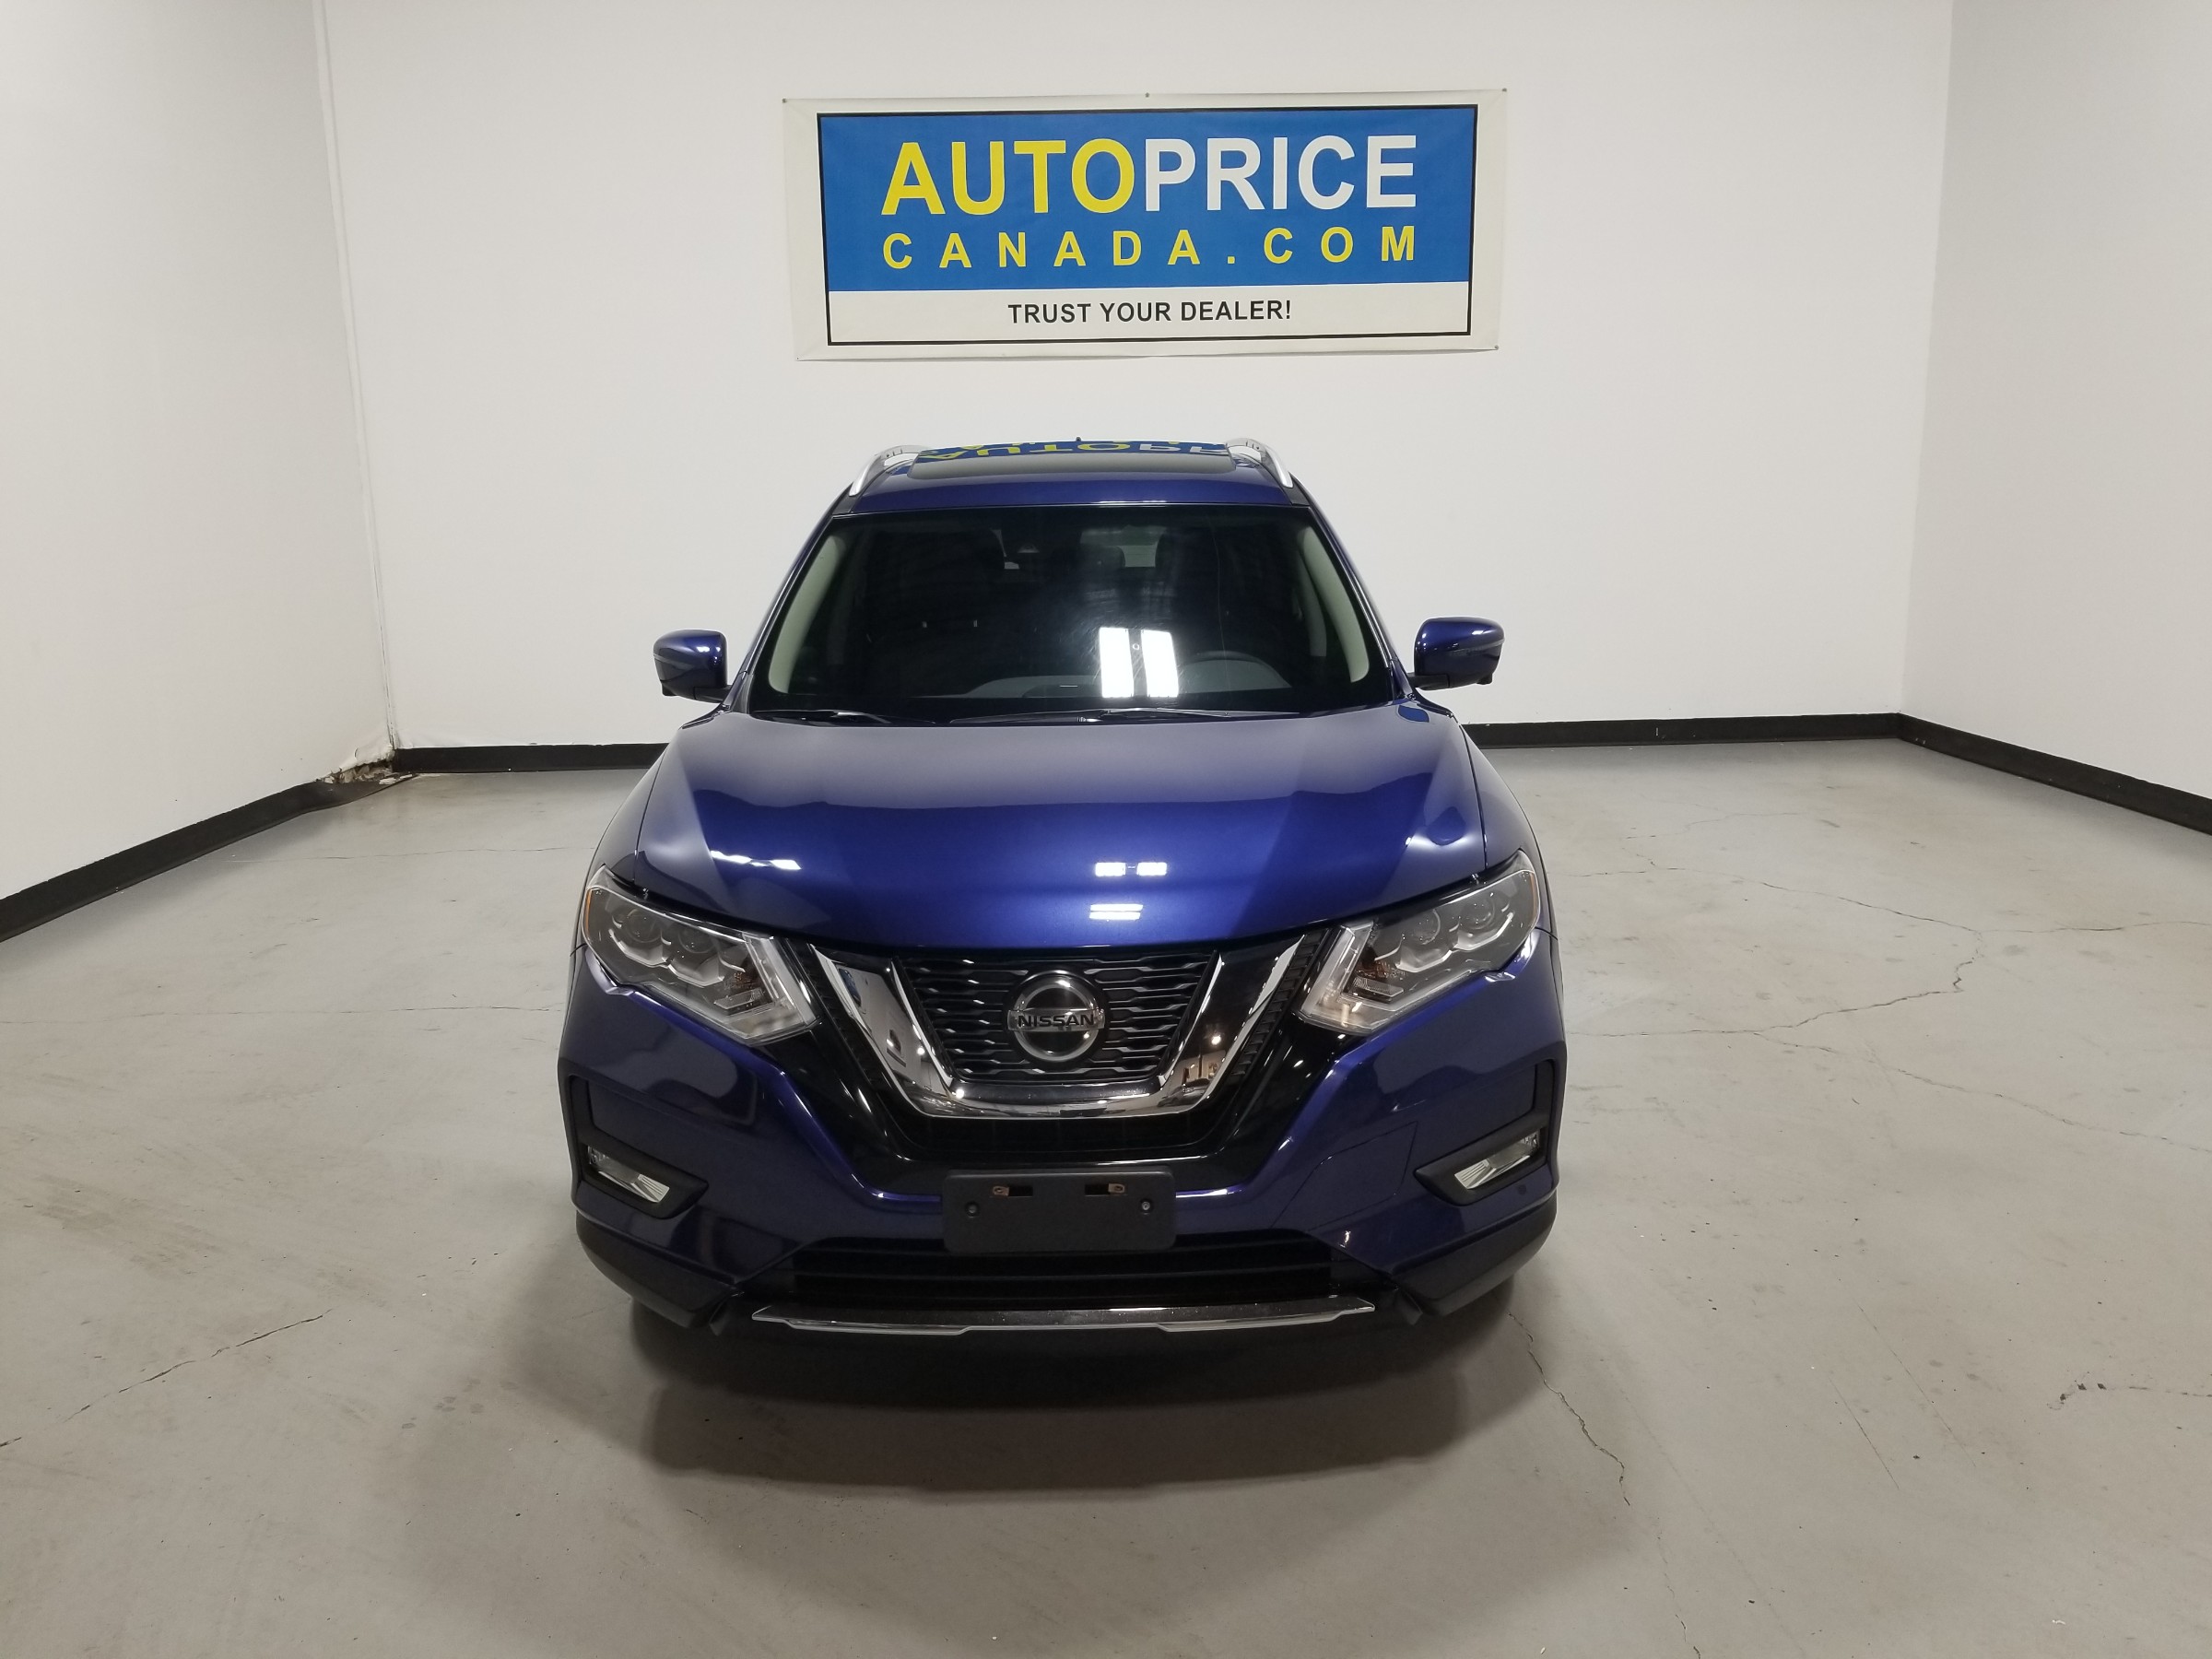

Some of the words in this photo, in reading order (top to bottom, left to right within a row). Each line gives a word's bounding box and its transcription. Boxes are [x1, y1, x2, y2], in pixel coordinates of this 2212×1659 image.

[881, 135, 1417, 216] AUTOPRICE
[882, 225, 1416, 270] CANADA.COM
[1007, 303, 1091, 324] TRUST
[1100, 302, 1171, 323] YOUR
[1181, 300, 1290, 322] DEALER!
[1018, 1014, 1094, 1028] NISSAN
